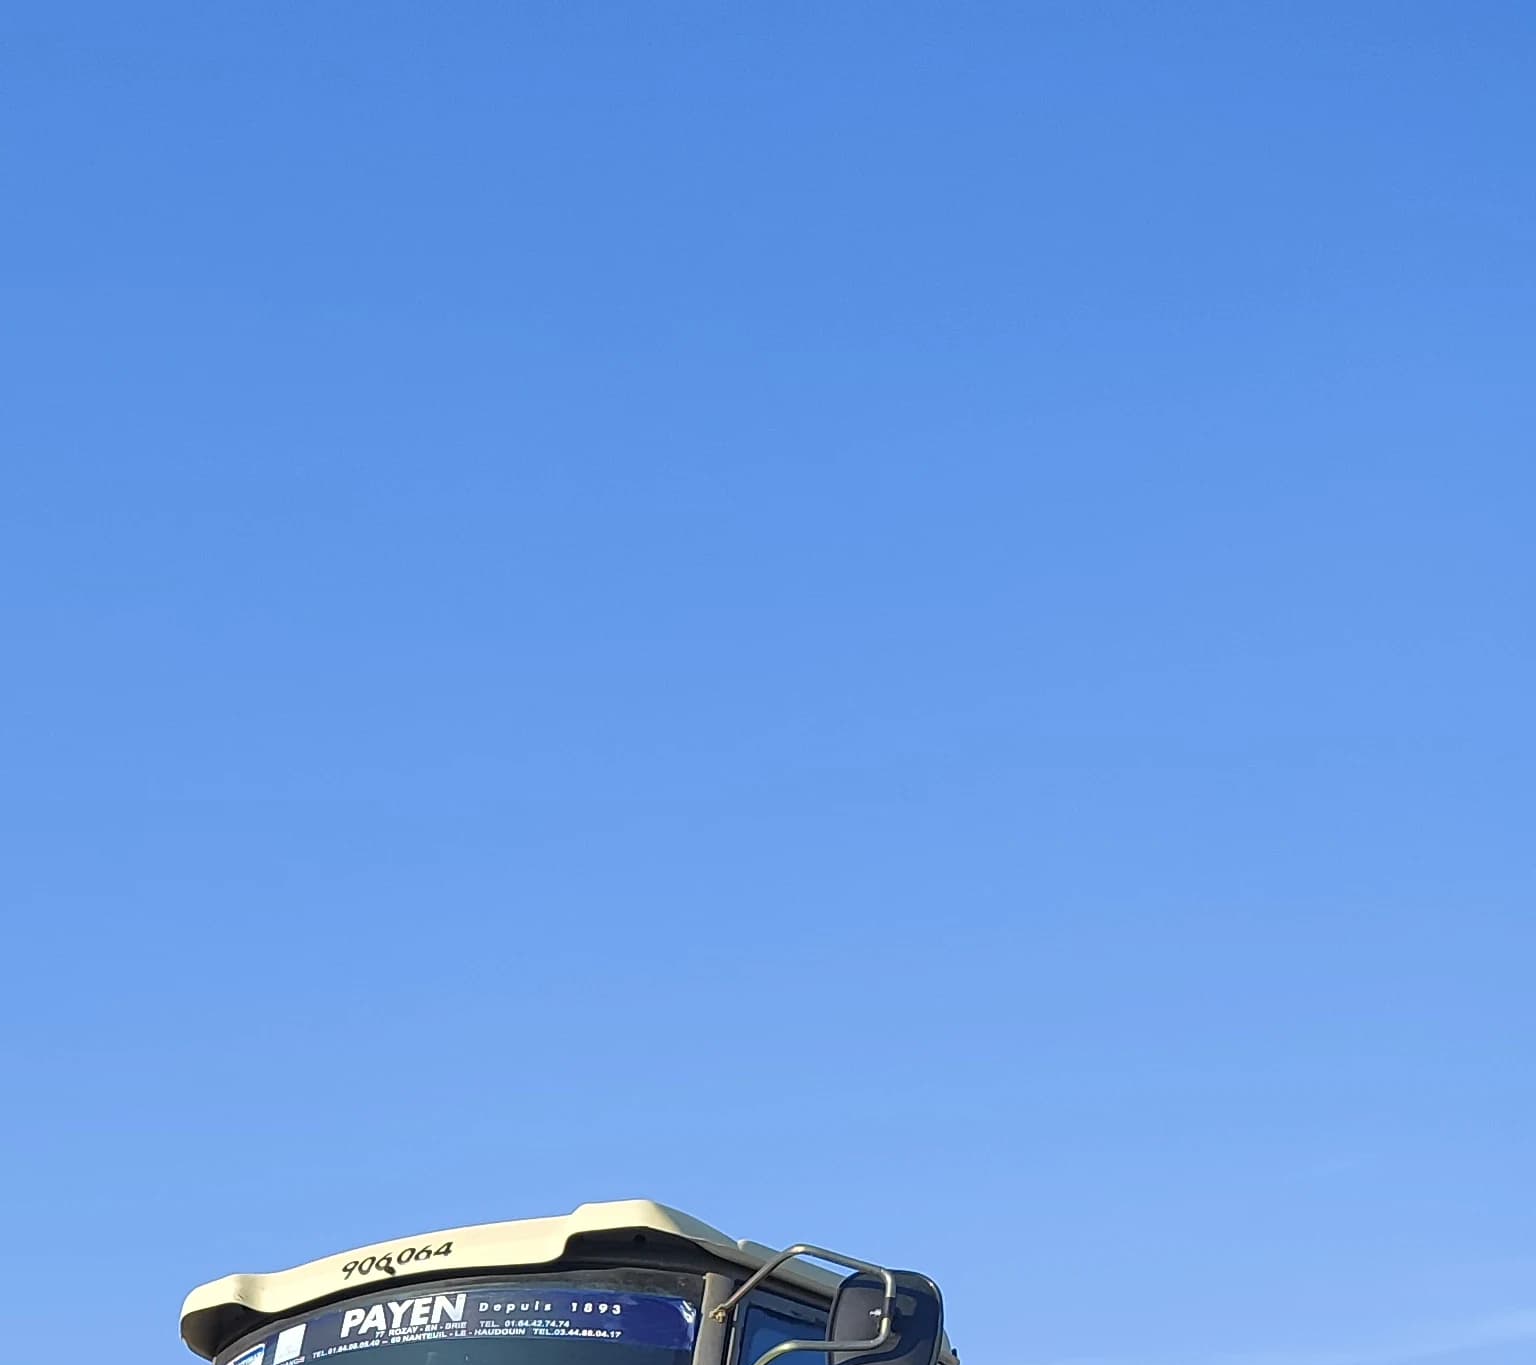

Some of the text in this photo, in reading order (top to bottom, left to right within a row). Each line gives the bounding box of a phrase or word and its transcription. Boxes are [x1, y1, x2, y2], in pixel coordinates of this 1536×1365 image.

[340, 1293, 467, 1338] PAYEN
[479, 1301, 621, 1315] Depuis 1893
[388, 1325, 418, 1336] ROZAY
[424, 1323, 437, 1331] EN
[445, 1321, 467, 1329] BRIE
[479, 1320, 499, 1328] TEL.
[402, 1331, 447, 1343] NANTEUIL
[474, 1328, 526, 1336] HAUDOUIN
